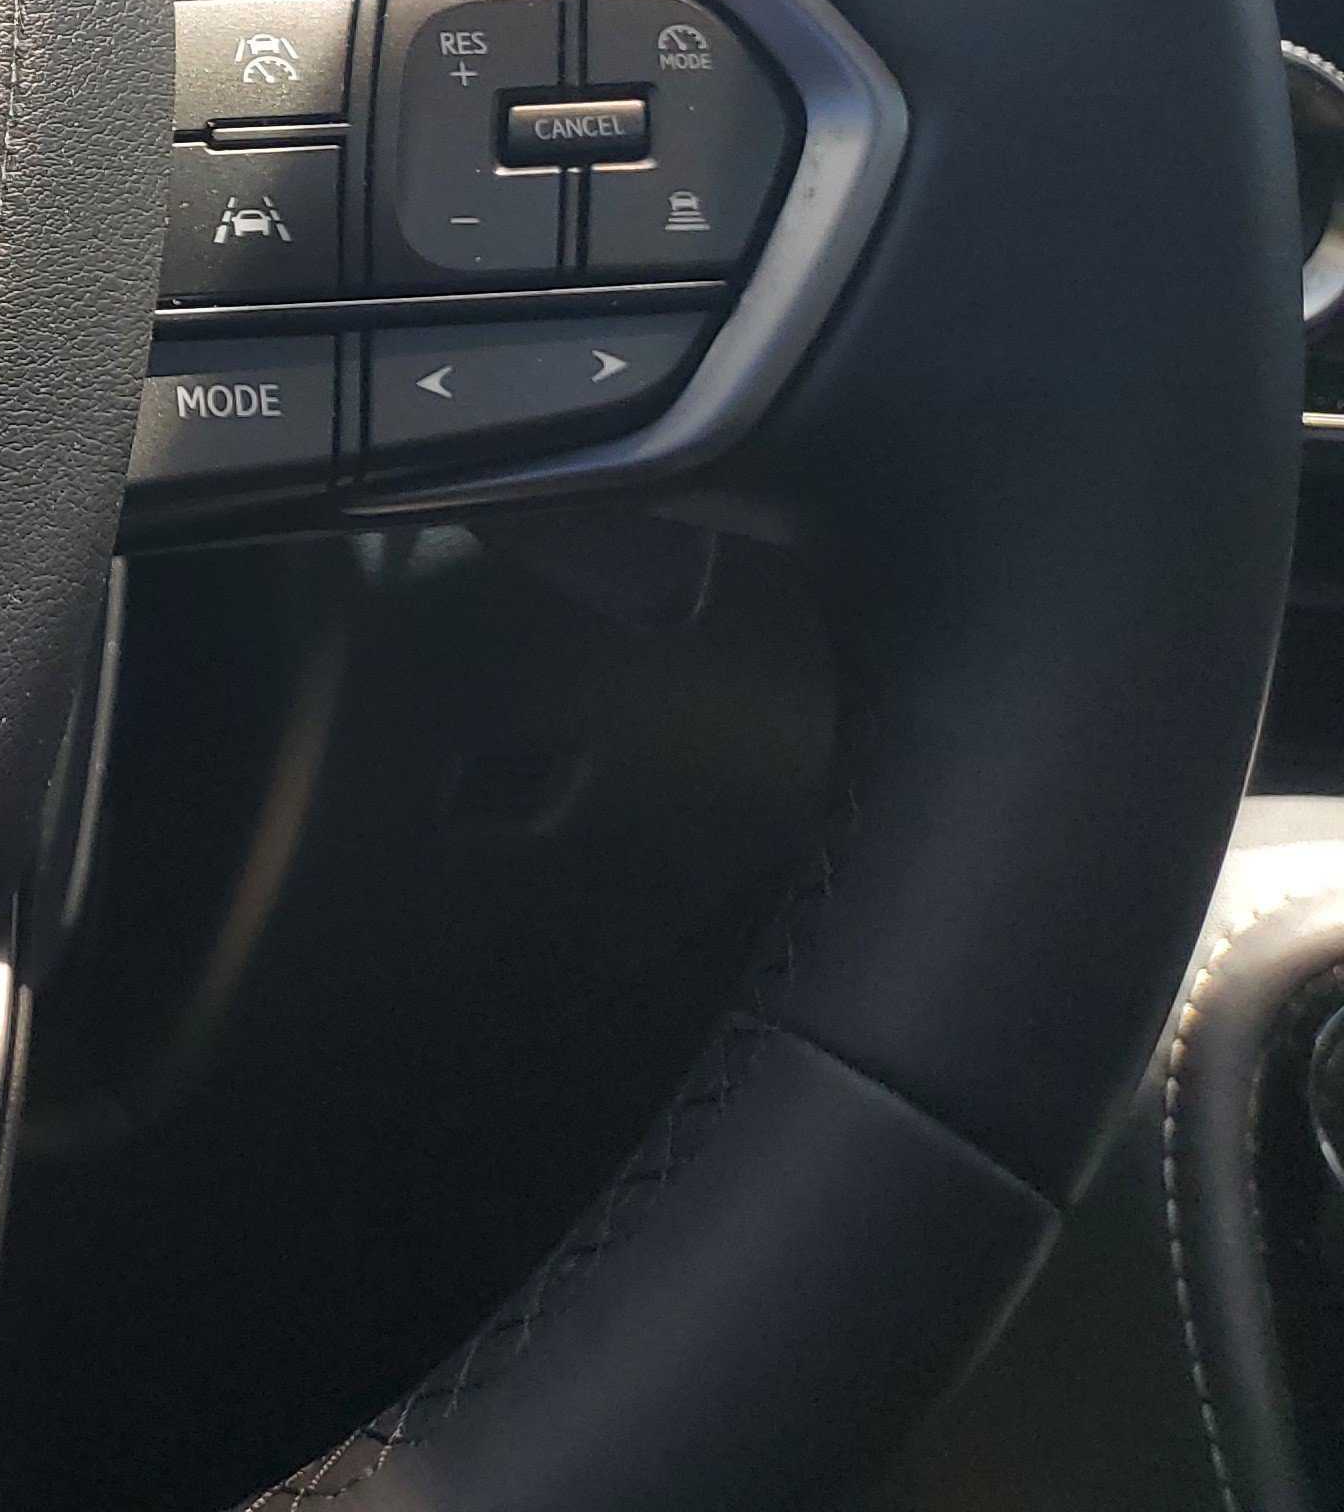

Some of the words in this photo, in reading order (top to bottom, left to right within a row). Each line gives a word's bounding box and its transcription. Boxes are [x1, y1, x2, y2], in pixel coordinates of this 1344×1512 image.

[440, 31, 488, 56] RES
[659, 53, 712, 71] MODE
[534, 115, 626, 140] CANCEL
[176, 383, 284, 420] MODE
